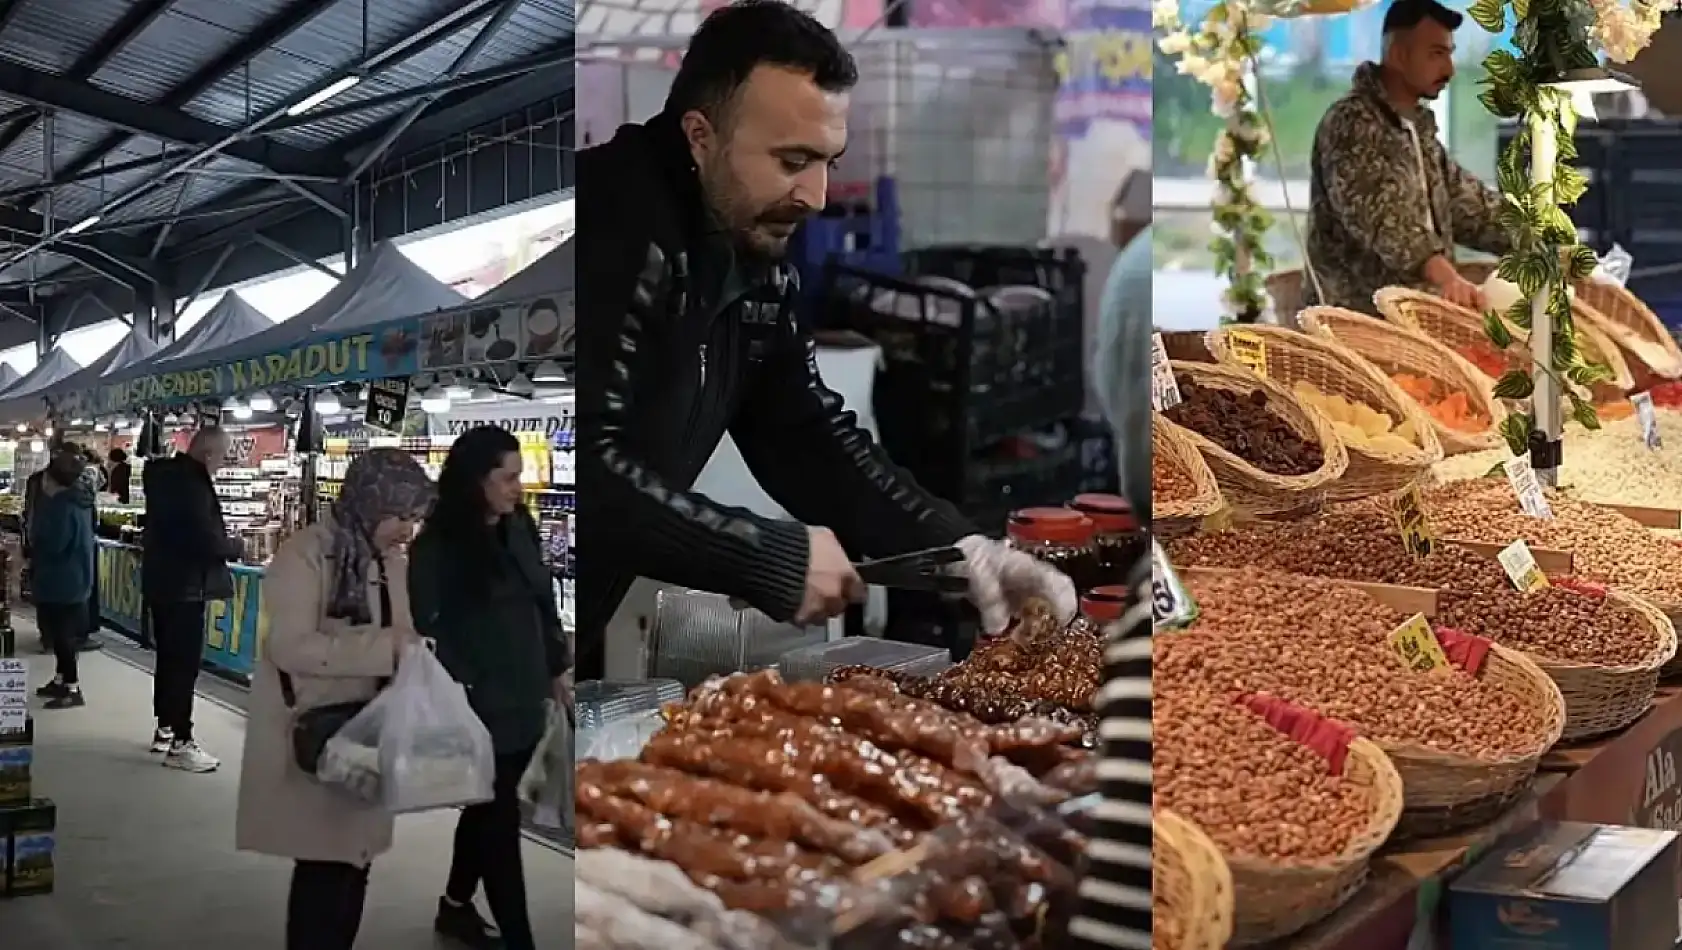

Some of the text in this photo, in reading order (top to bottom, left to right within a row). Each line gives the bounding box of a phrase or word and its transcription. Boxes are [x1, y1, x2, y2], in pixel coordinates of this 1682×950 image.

[230, 334, 375, 393] KARADUT
[447, 417, 543, 437] KADUT
[1645, 747, 1676, 808] Ala
